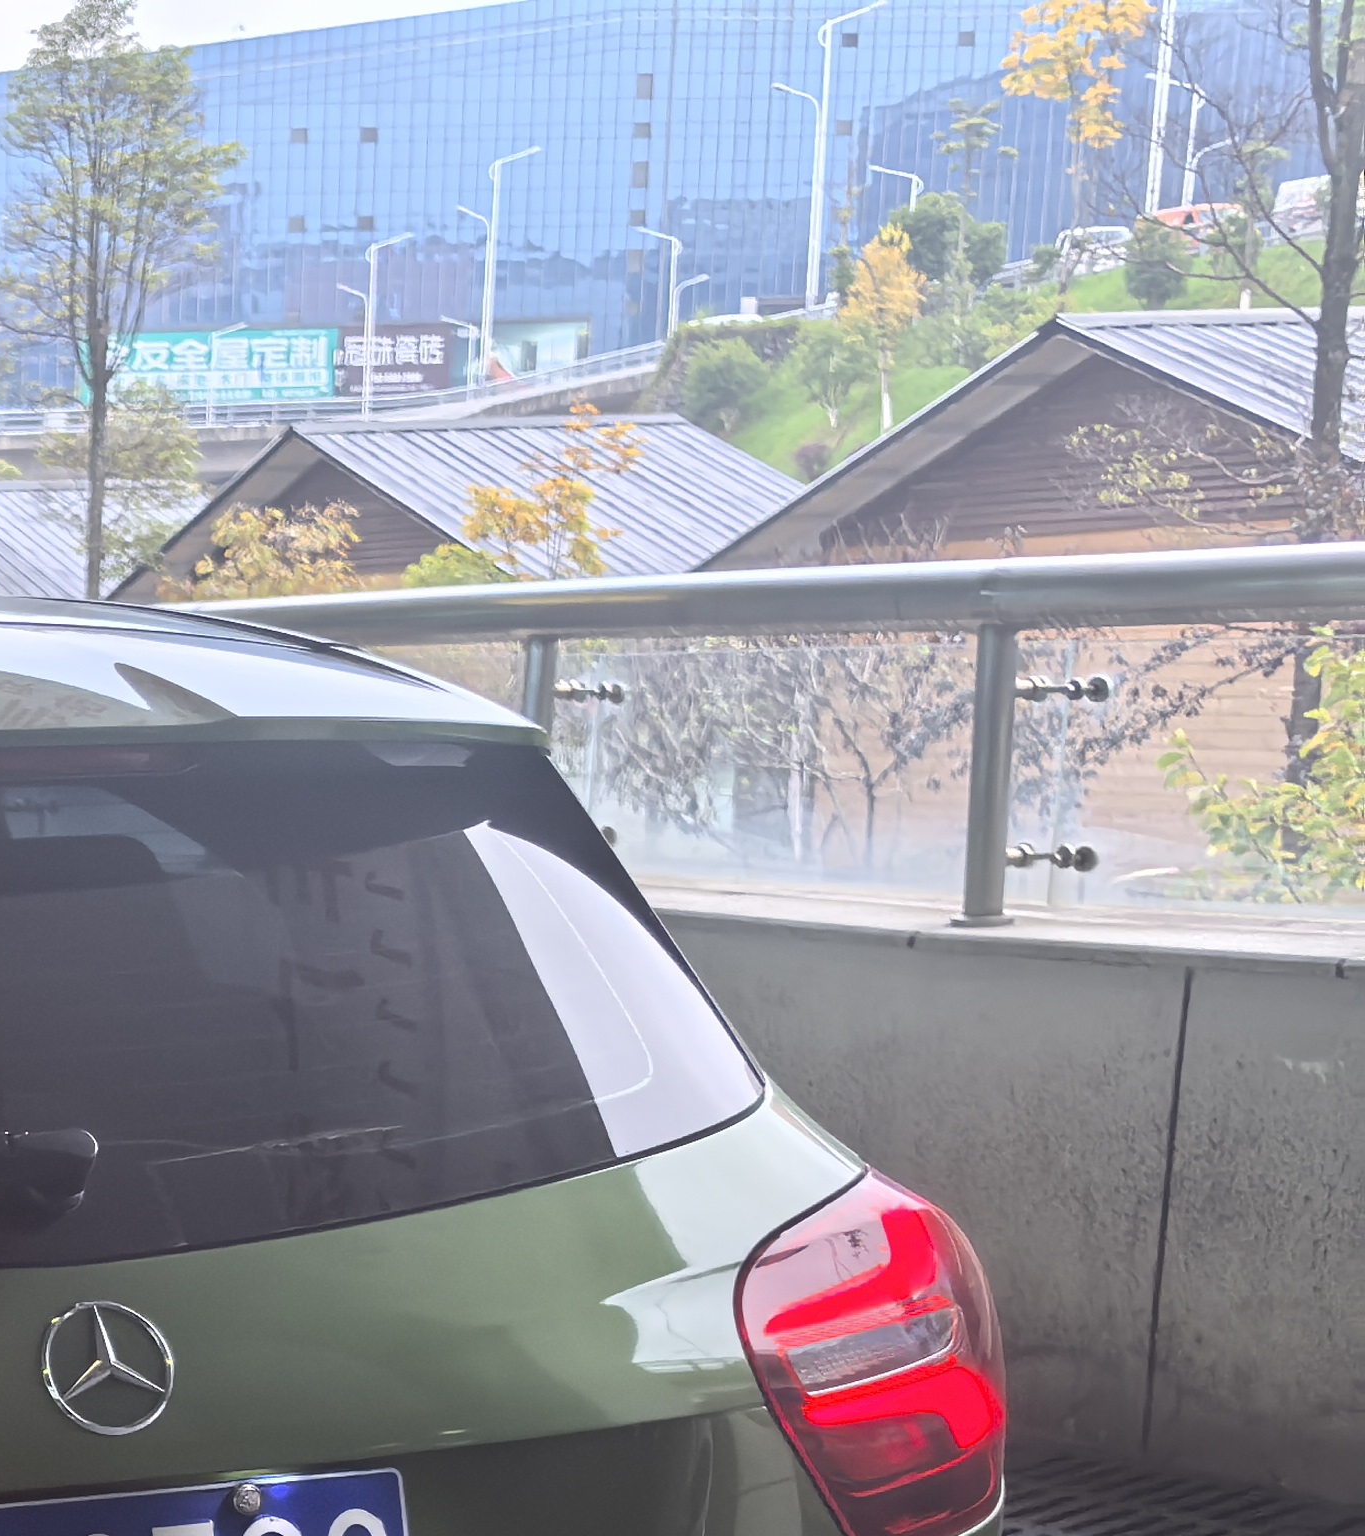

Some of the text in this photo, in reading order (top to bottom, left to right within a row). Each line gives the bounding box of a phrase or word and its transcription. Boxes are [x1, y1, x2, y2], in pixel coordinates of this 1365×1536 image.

[105, 336, 329, 371] 友全屋定制
